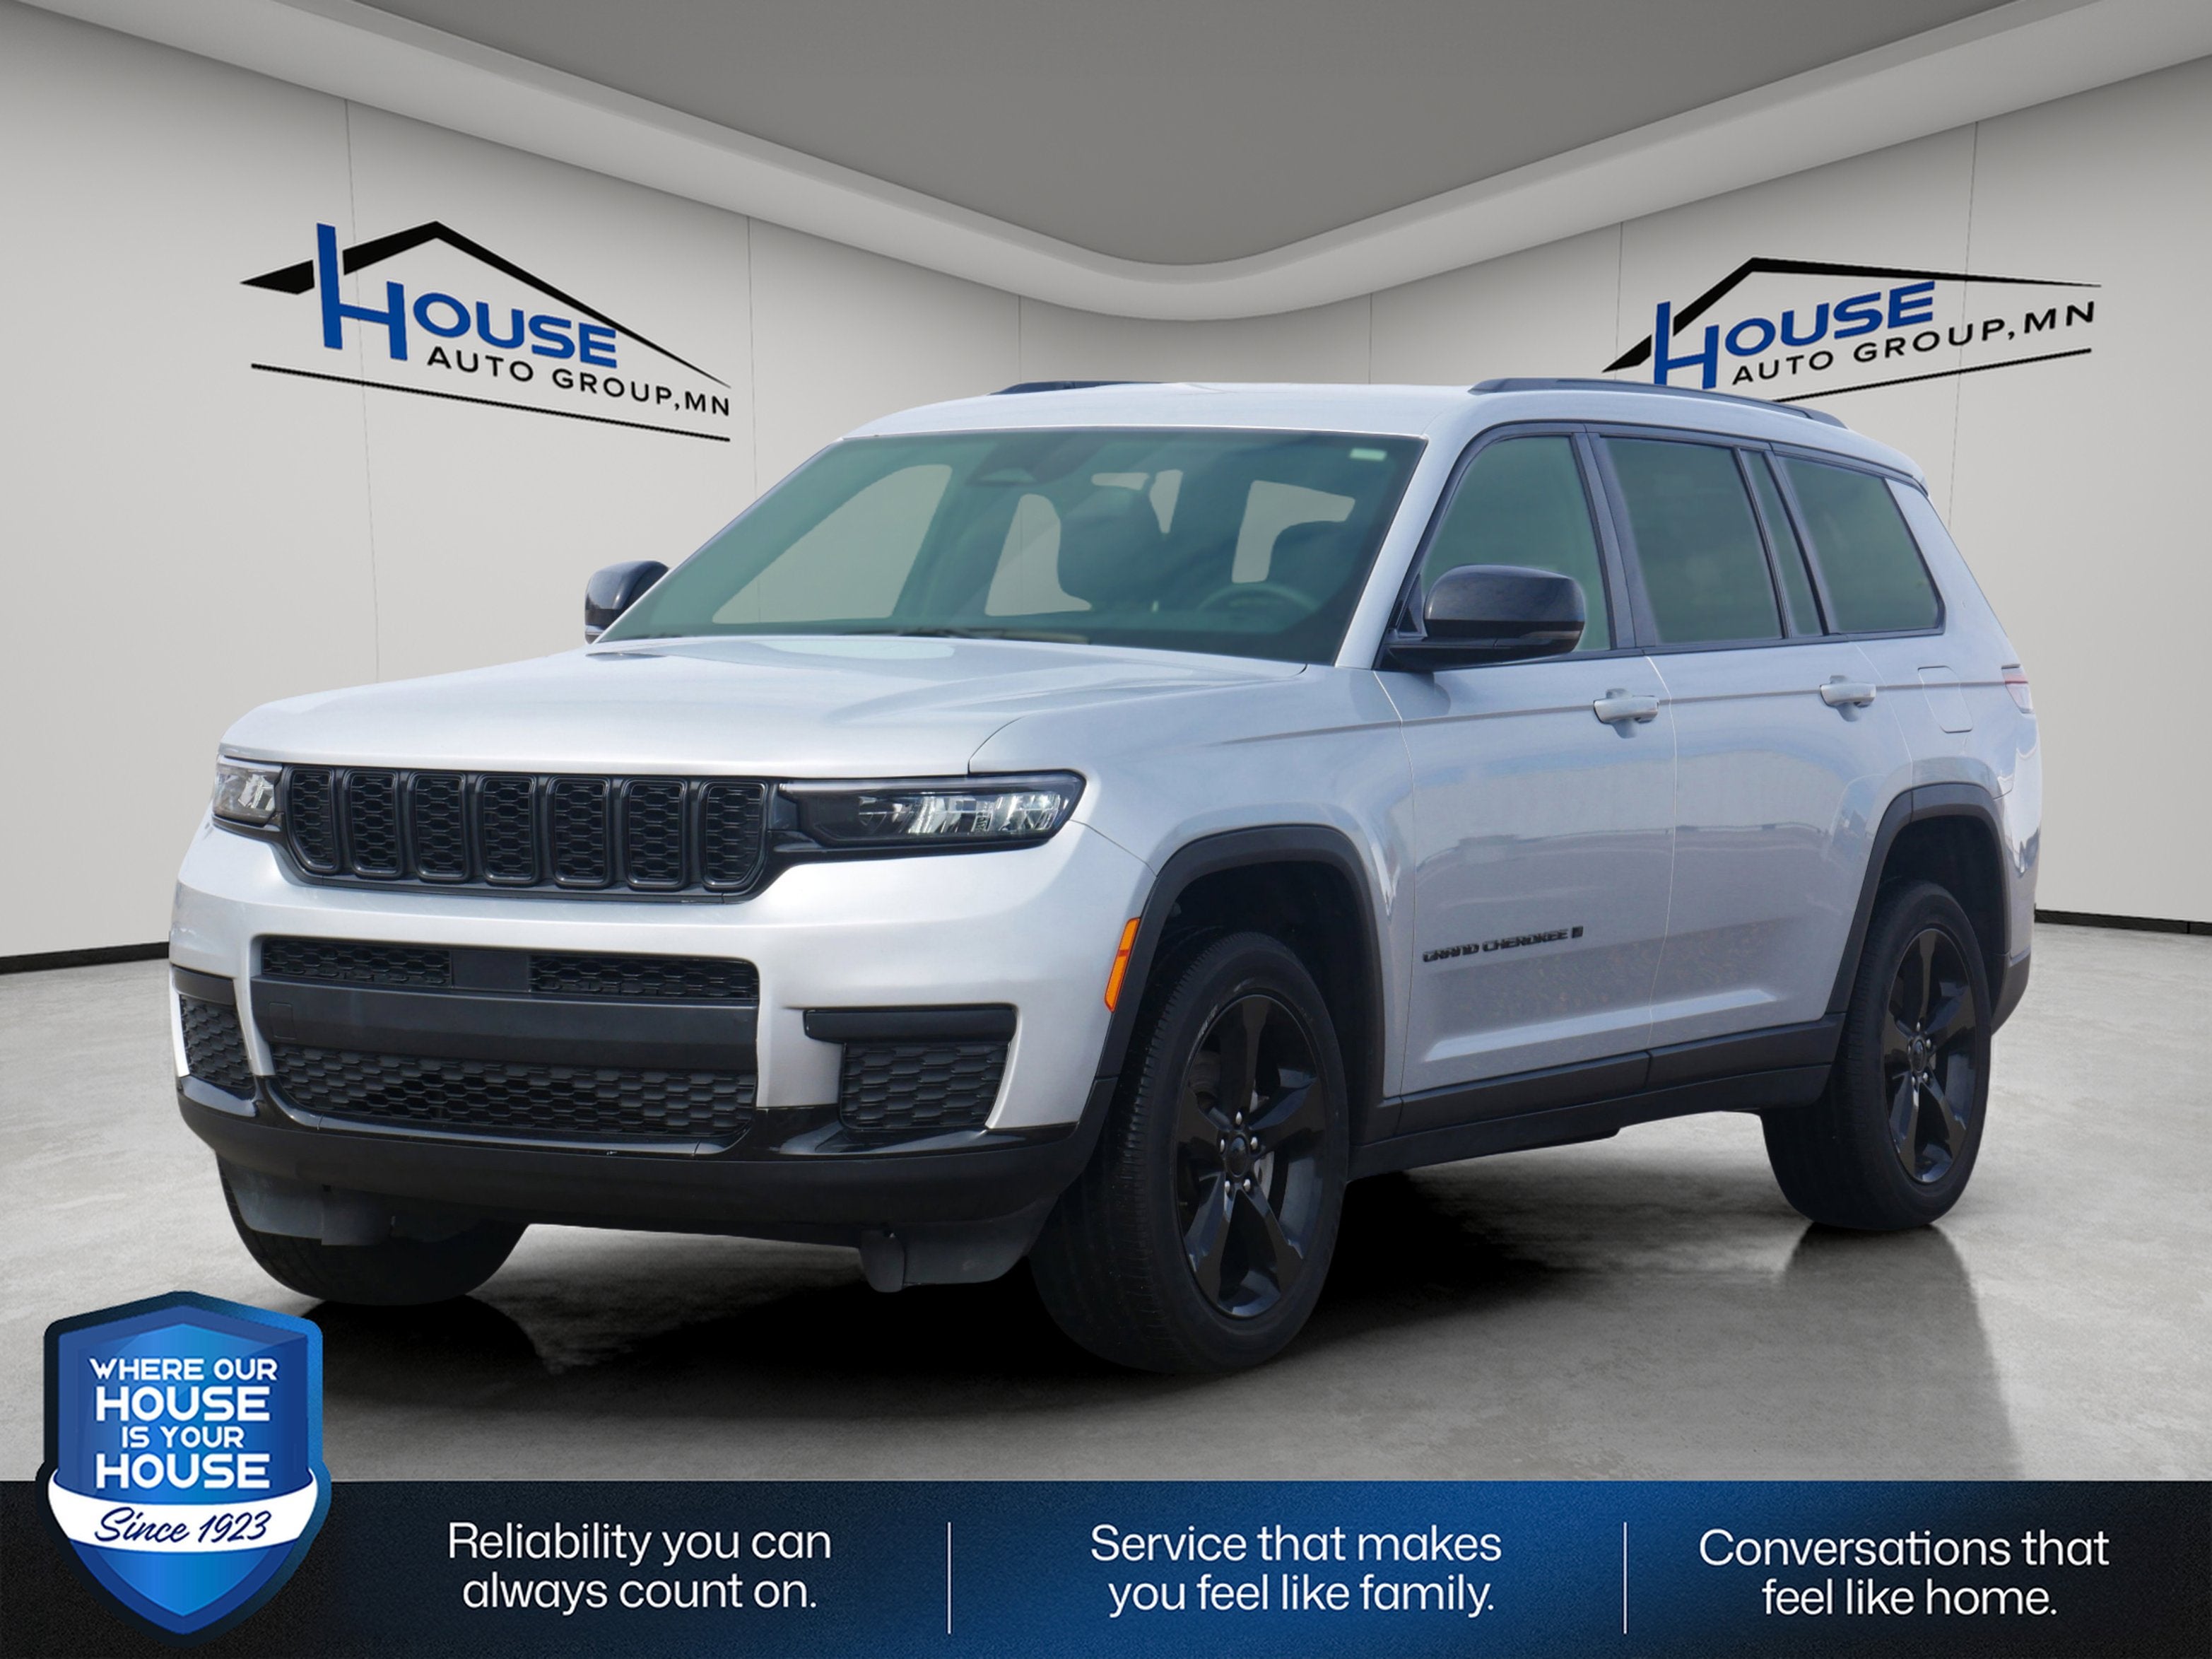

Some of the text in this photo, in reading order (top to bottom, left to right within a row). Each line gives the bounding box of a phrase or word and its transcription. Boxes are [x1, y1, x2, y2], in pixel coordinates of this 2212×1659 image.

[317, 223, 618, 368] HOUSE
[1654, 281, 1935, 389] HOUSE
[426, 346, 534, 382] AUTO
[1732, 351, 1834, 385] AUTO
[1423, 943, 1479, 962] GRAND
[1482, 928, 1568, 952] CHEROKEE
